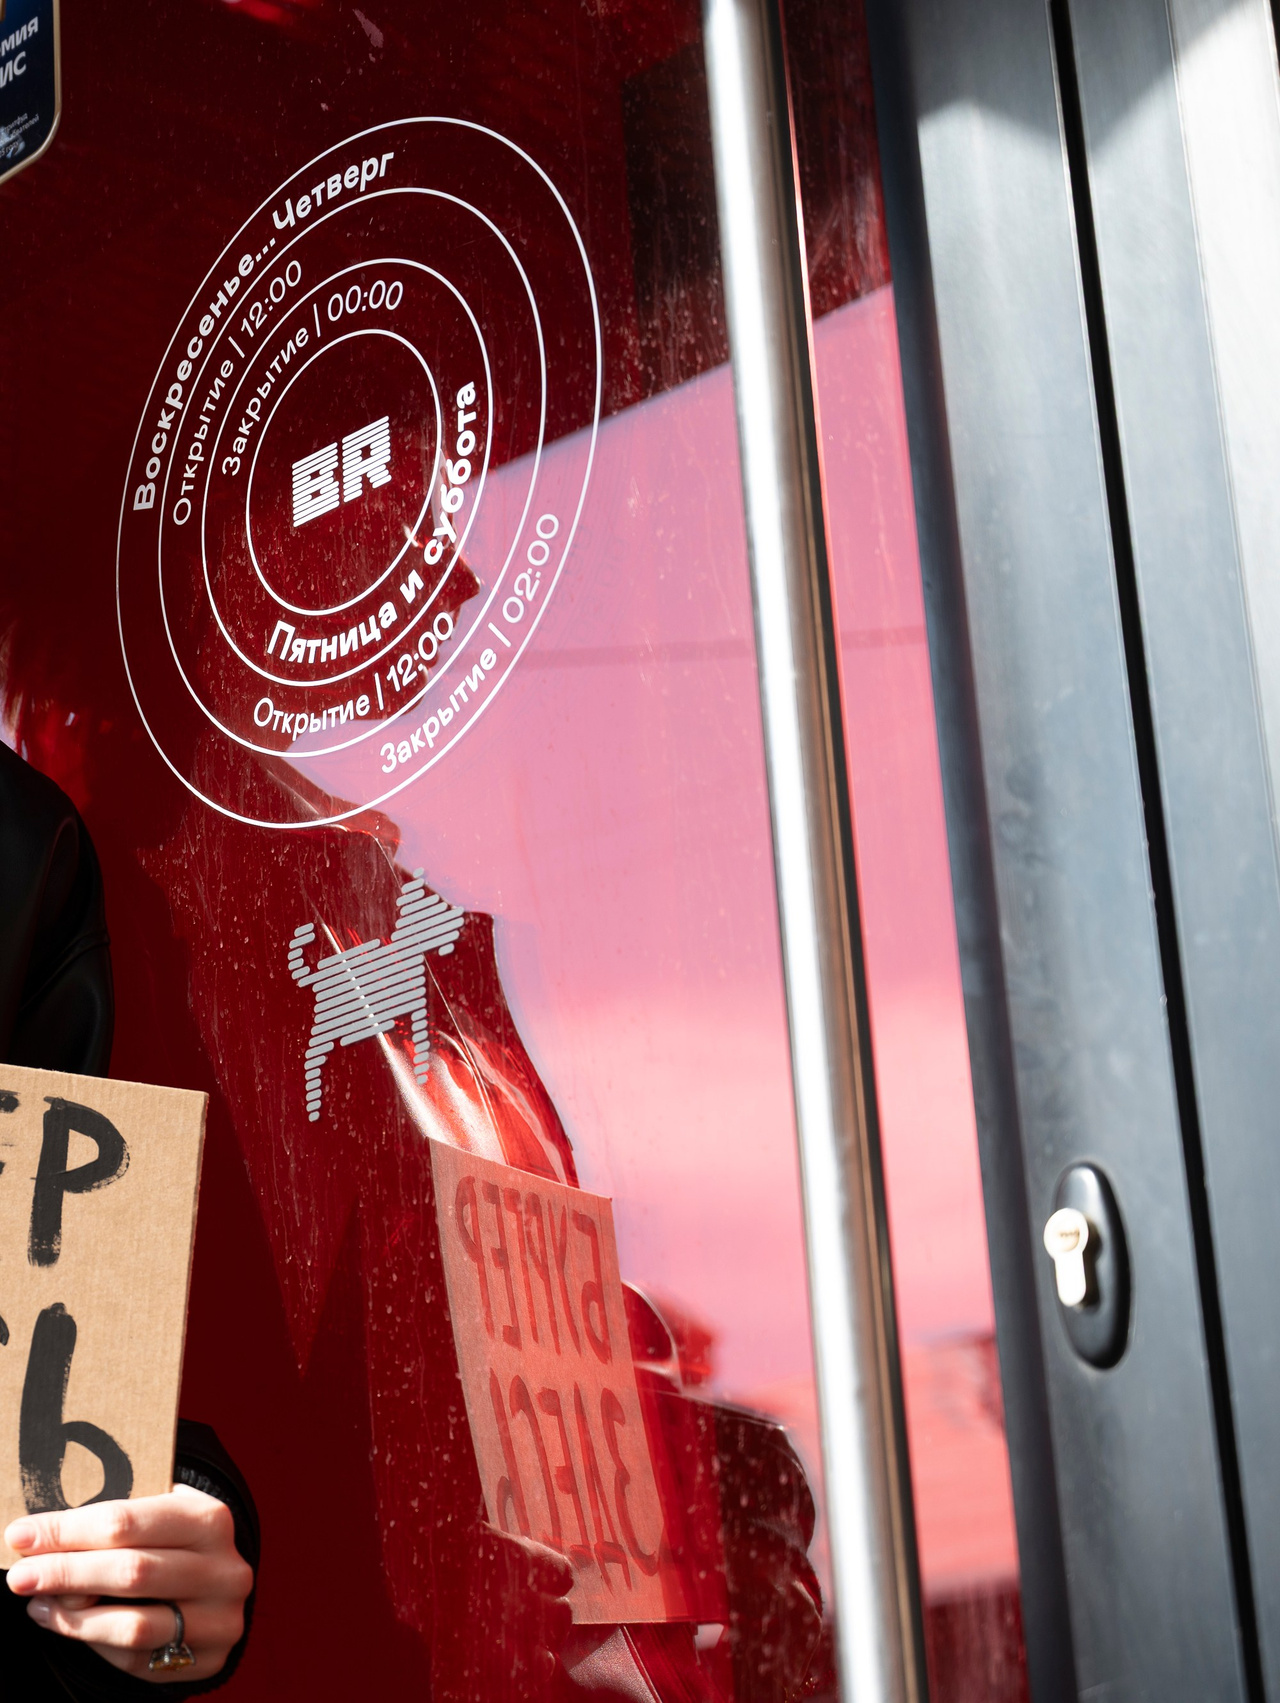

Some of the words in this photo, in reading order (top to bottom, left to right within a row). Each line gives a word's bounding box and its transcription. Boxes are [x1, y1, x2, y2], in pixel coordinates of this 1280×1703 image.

[272, 151, 394, 231] Четверг
[173, 358, 234, 526] Открытие
[239, 259, 302, 340] 12:00
[222, 324, 309, 476] Закрытие
[327, 280, 404, 322] 00:00
[292, 415, 392, 527] BR
[267, 600, 398, 664] Пятница
[399, 571, 424, 602] и
[423, 381, 476, 565] суббота
[253, 696, 370, 741] Открытие
[386, 611, 454, 692] 12:00
[380, 647, 497, 774] Закрытие
[501, 513, 560, 624] 02:00
